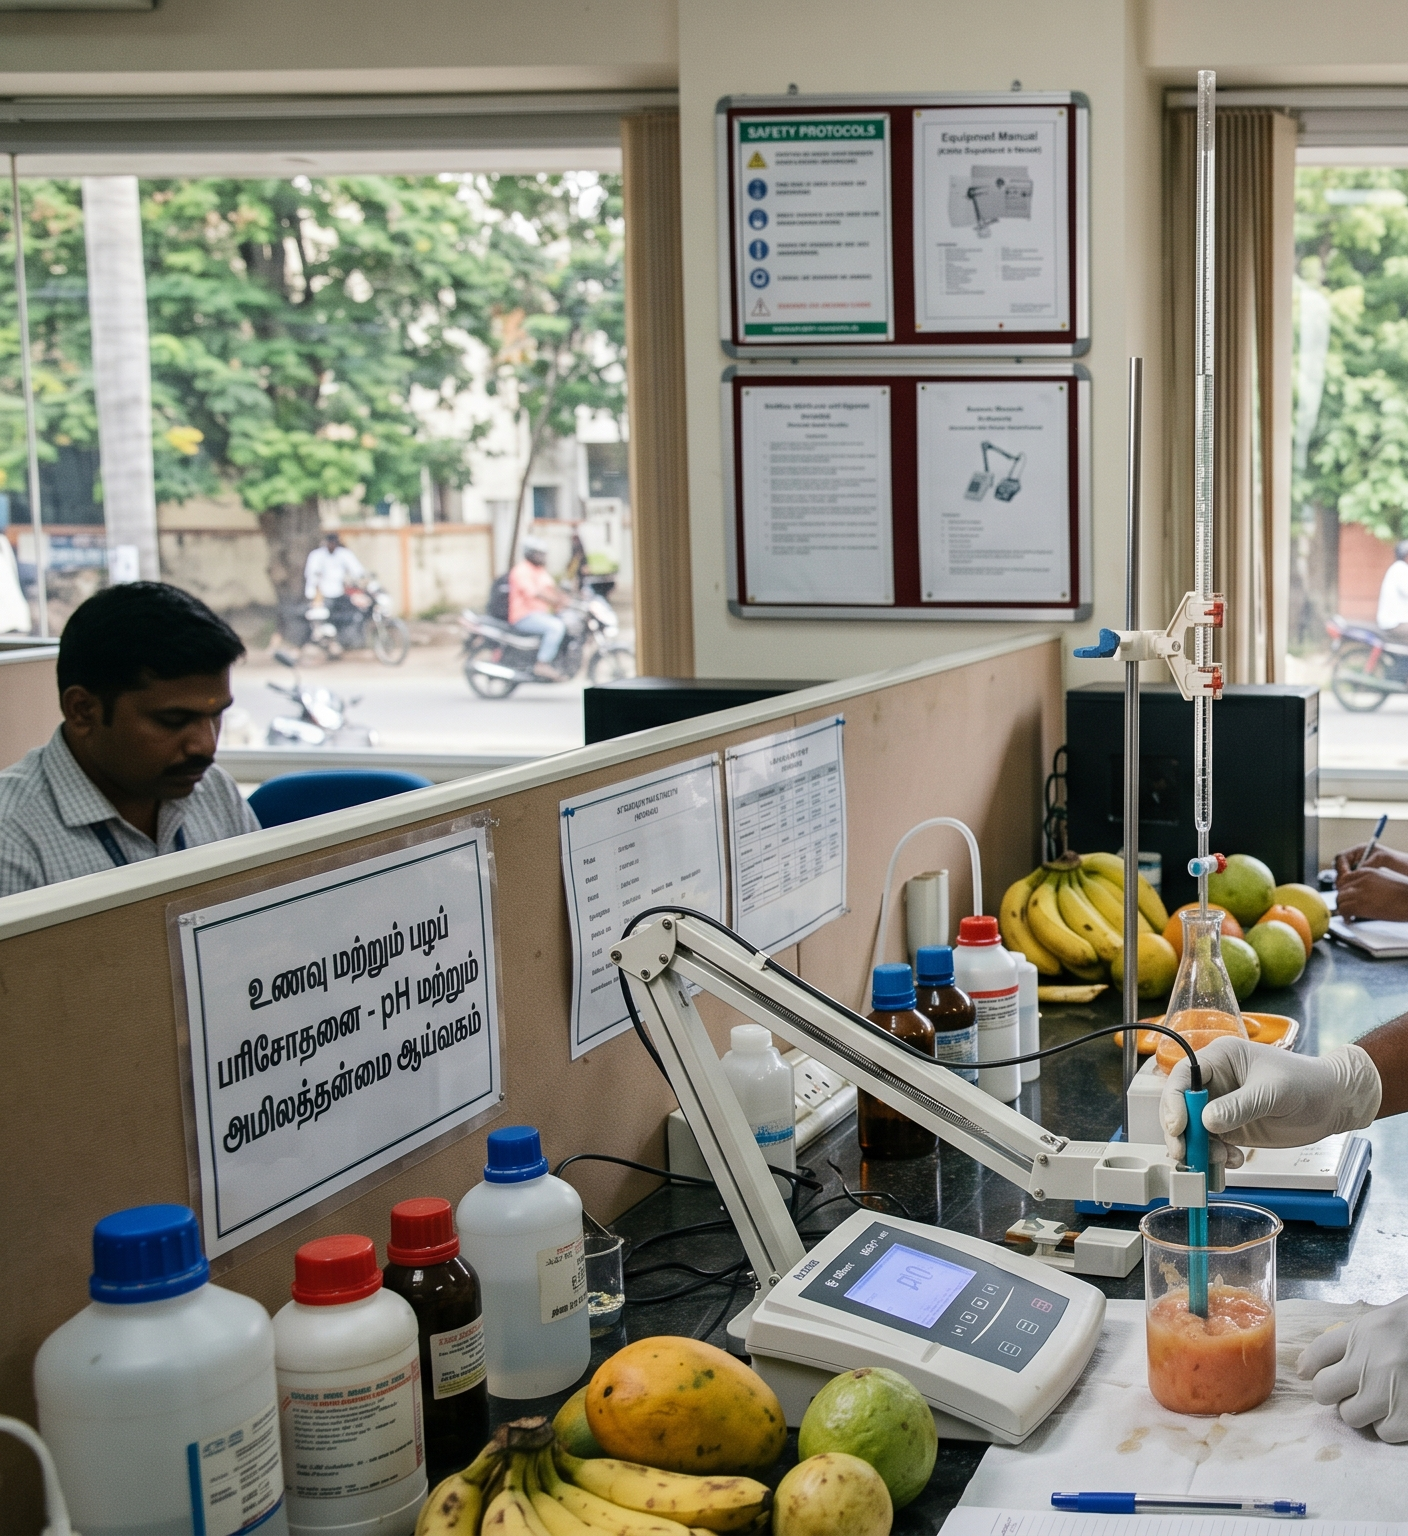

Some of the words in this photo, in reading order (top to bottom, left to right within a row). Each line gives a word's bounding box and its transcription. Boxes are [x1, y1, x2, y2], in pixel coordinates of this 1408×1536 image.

[747, 125, 797, 139] SAFETY
[799, 123, 876, 138] PROTOCOLS
[217, 1004, 362, 1090] பரிசோதனை
[381, 976, 411, 1031] pH
[416, 949, 479, 1008] மற்றும்
[248, 956, 329, 1011] உணவு
[332, 920, 405, 985] மற்றும்
[409, 904, 449, 957] பழப்
[222, 1052, 392, 1154] அமிலத்தன்மை
[396, 1002, 482, 1072] ஆய்வகம்
